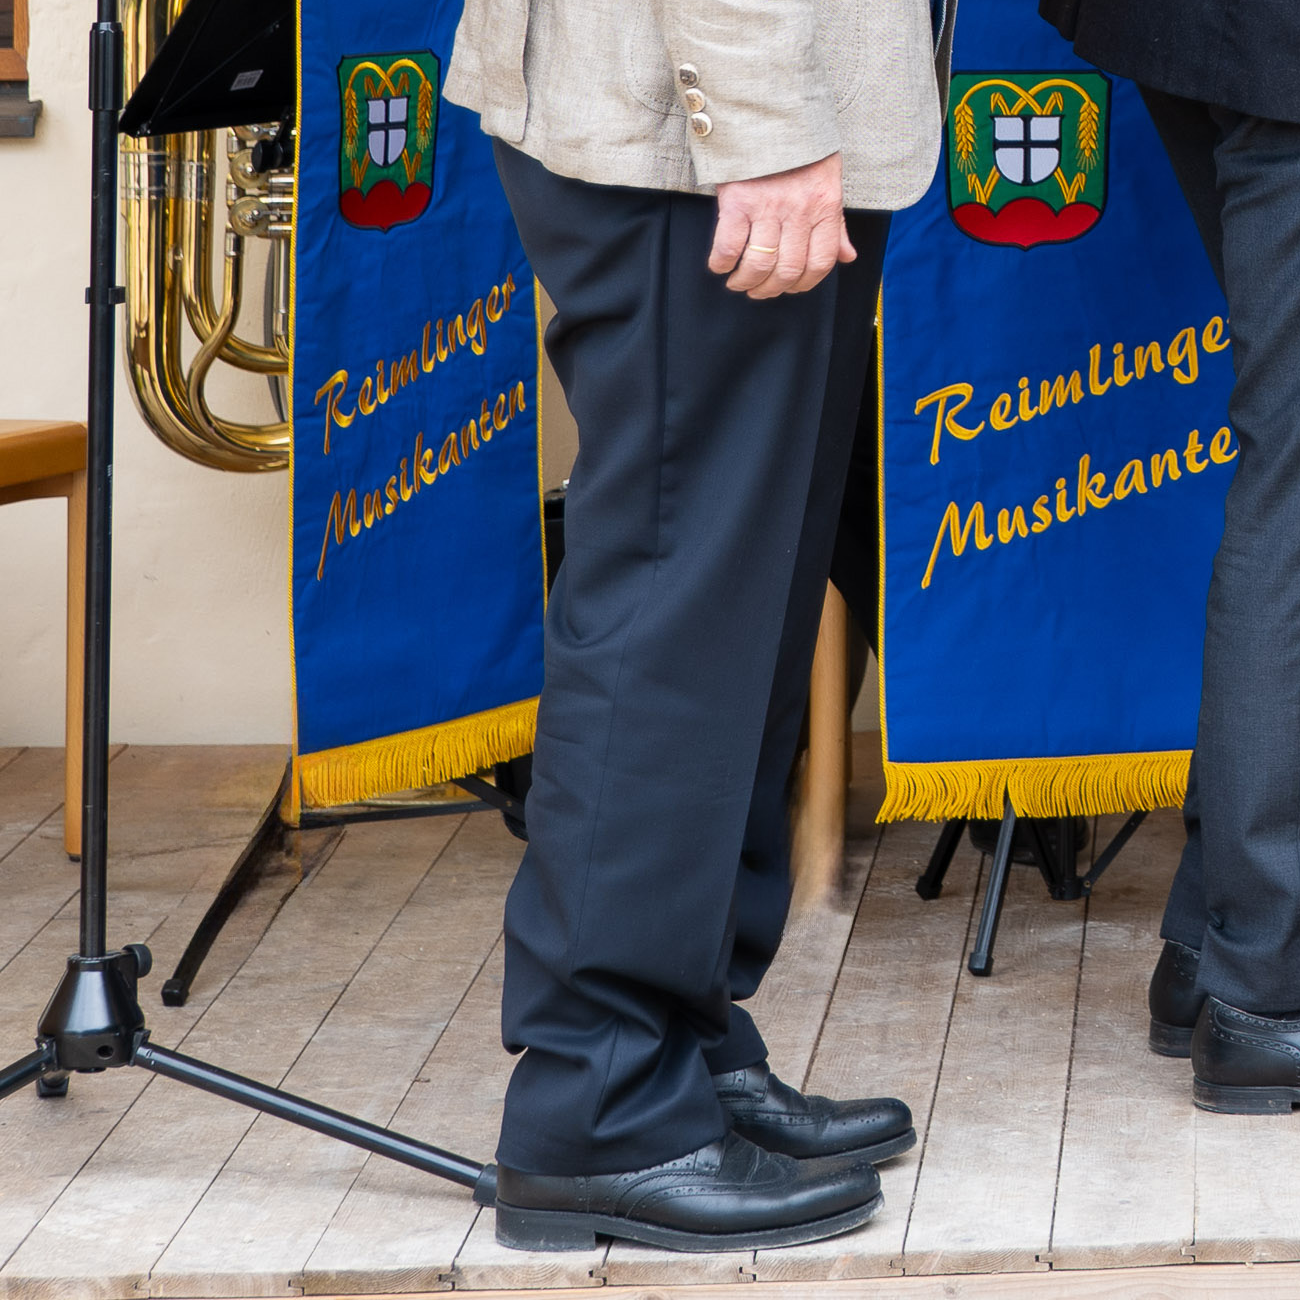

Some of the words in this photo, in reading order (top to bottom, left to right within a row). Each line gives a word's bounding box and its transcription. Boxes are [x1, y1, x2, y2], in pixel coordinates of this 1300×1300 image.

[314, 272, 516, 455] Reimlinger
[914, 315, 1231, 465] Reimlinge
[317, 380, 526, 581] Musikanten
[921, 426, 1240, 589] Musikante
